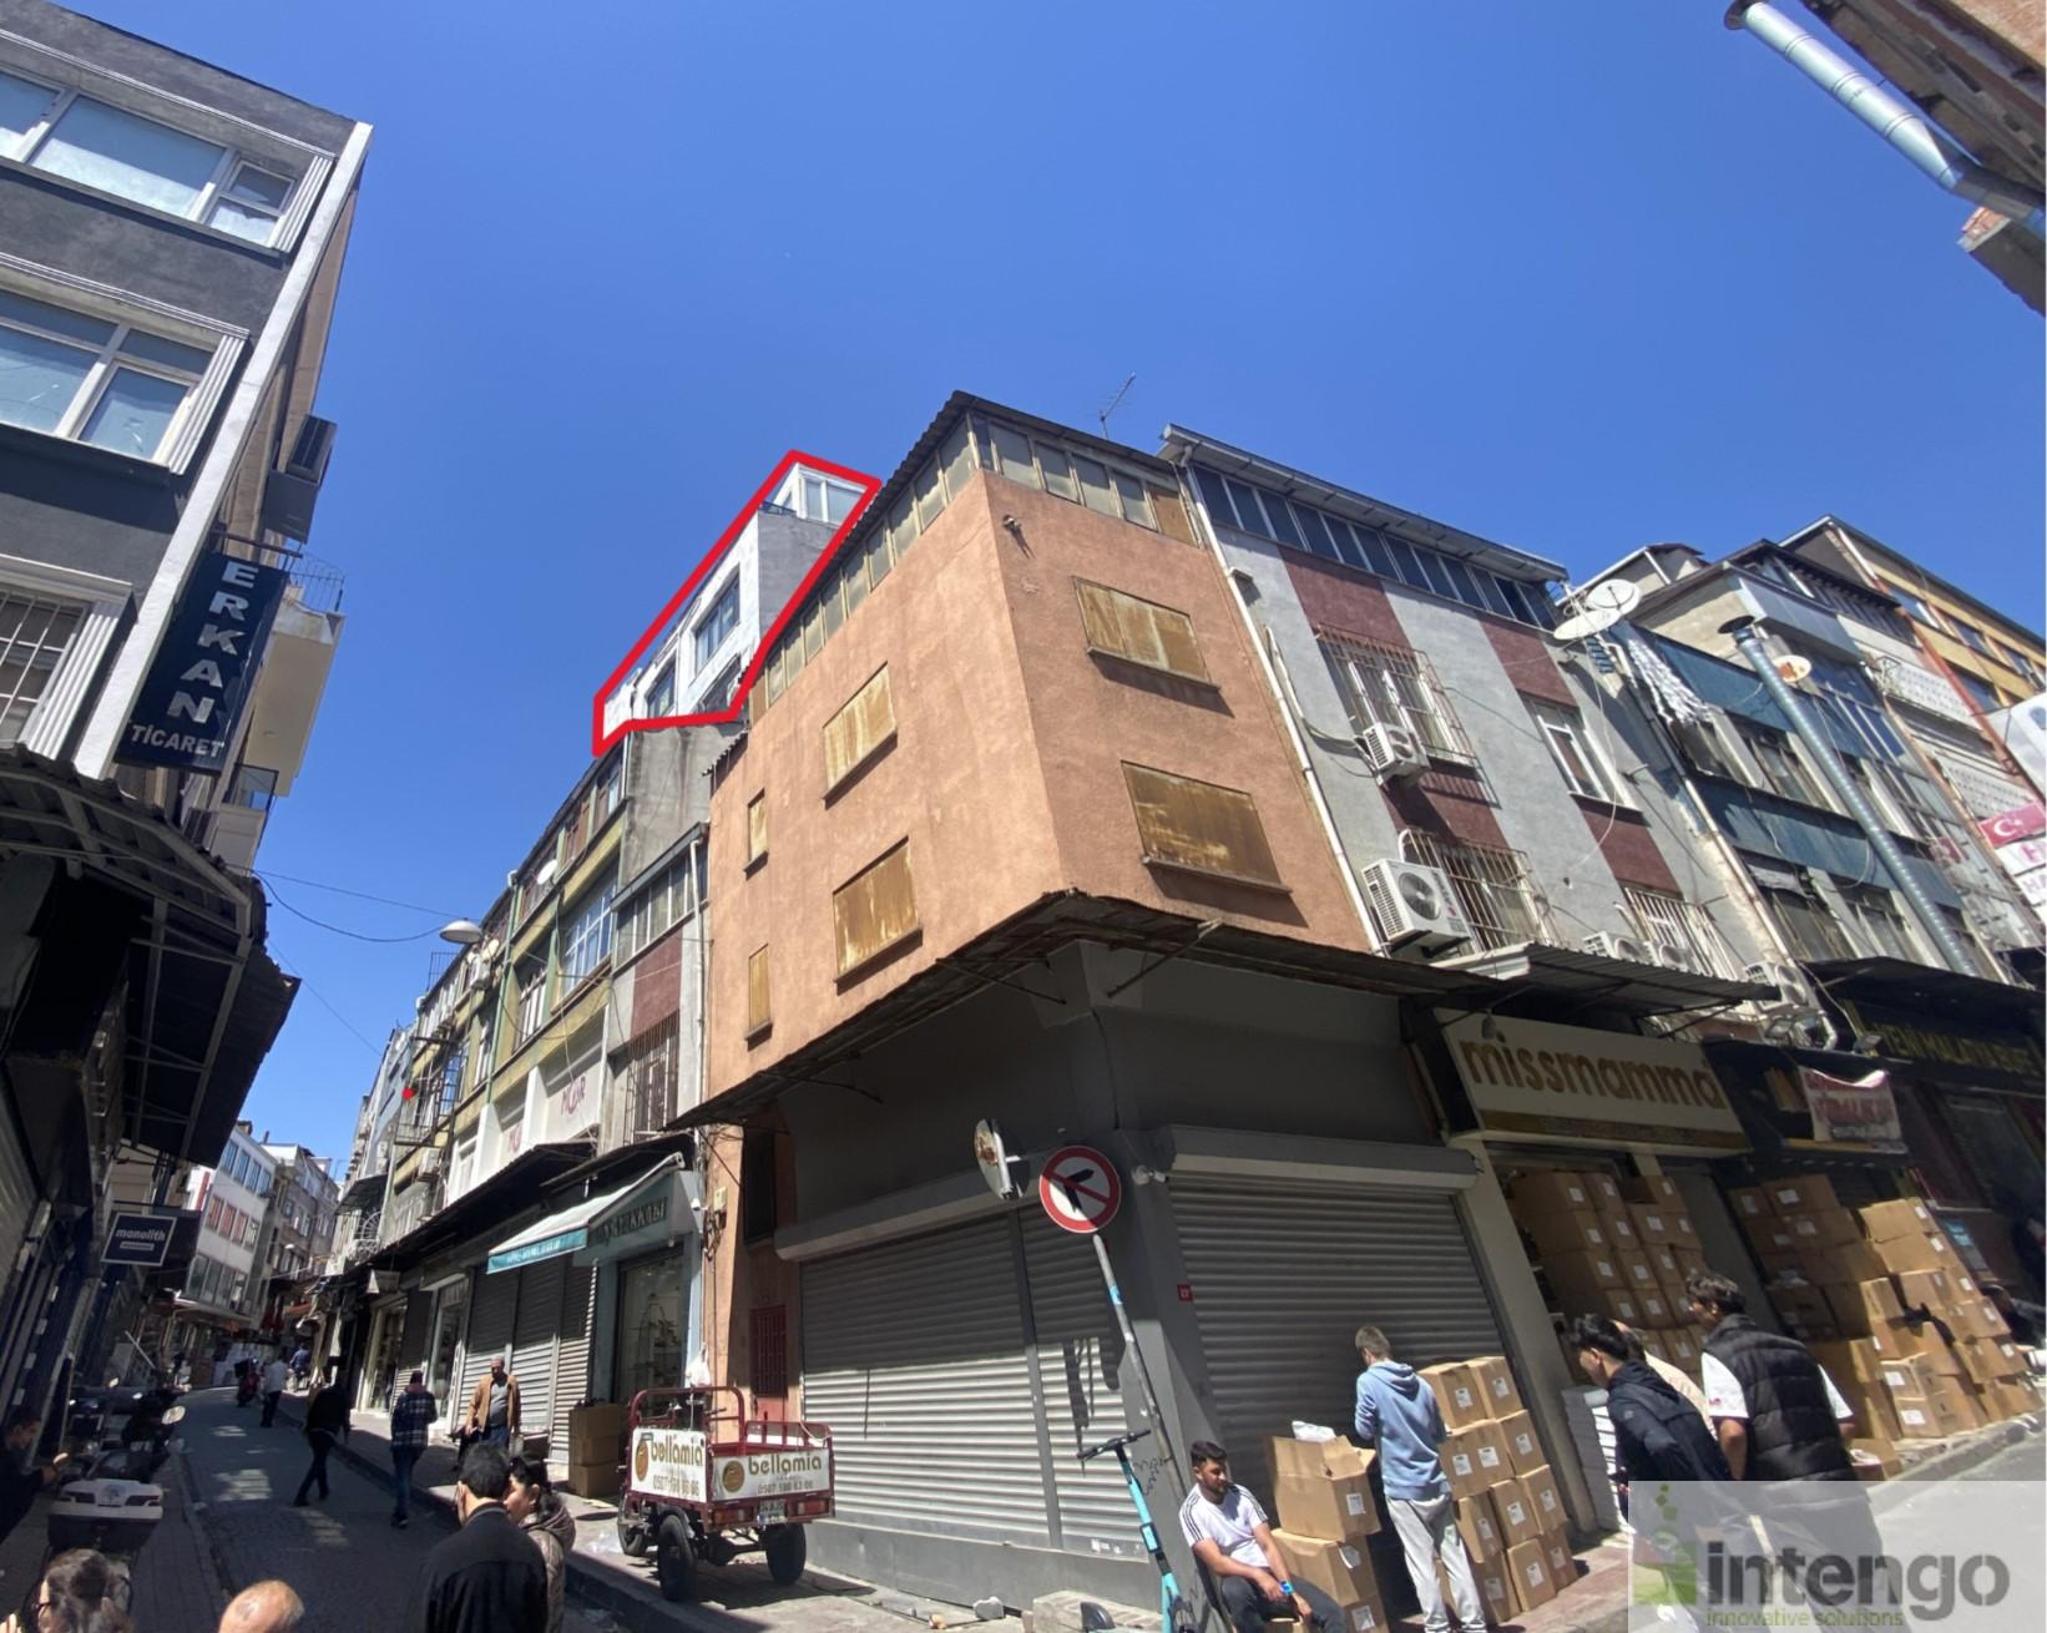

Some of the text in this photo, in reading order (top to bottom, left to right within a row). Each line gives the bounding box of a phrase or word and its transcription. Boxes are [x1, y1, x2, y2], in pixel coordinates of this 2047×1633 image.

[167, 560, 259, 724] ERKAN
[131, 725, 224, 758] TİCARET
[1458, 1034, 1728, 1110] missmamma
[651, 1432, 704, 1467] bellamia
[748, 1452, 822, 1475] bellamia
